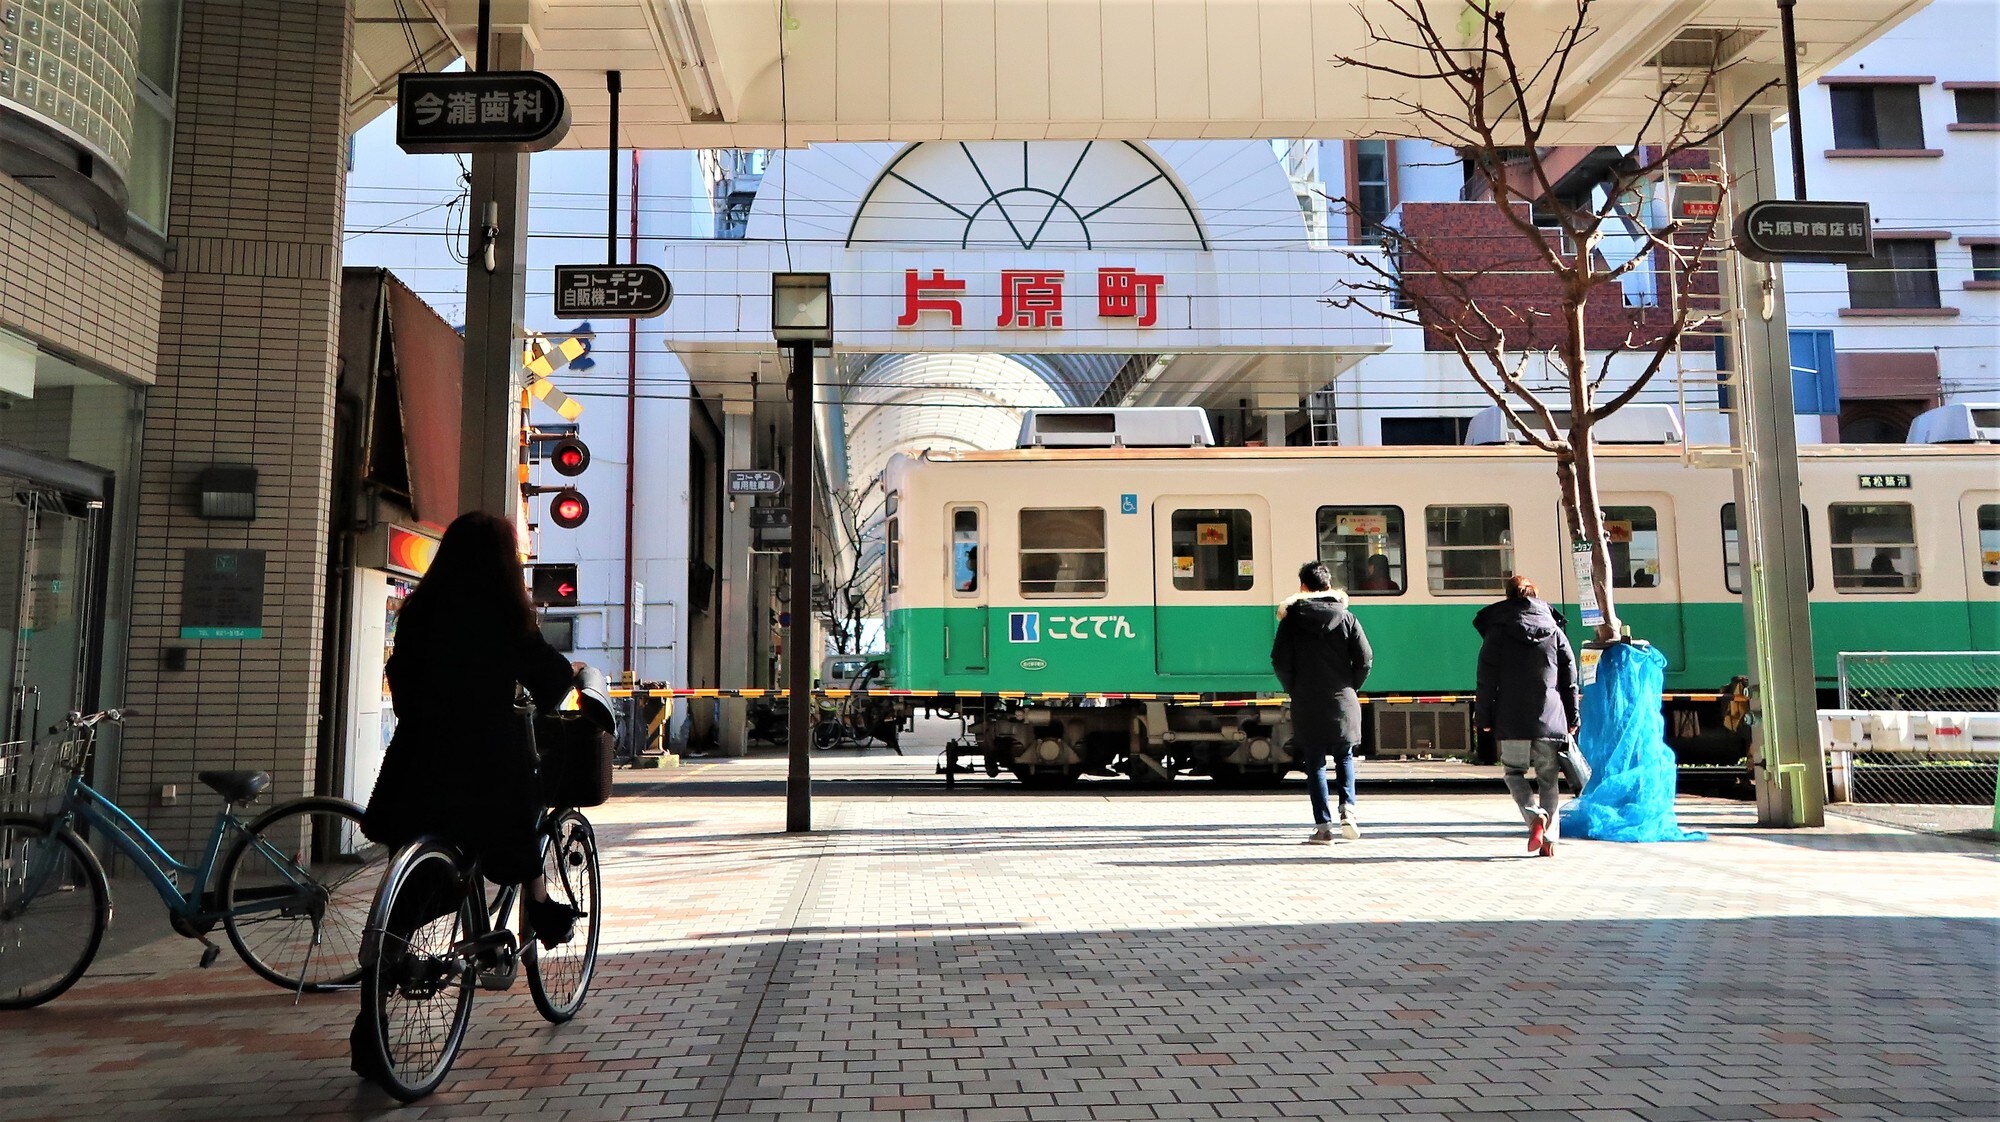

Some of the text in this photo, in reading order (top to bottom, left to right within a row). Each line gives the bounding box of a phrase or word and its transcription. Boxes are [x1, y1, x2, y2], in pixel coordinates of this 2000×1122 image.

[413, 90, 544, 126] 今瀧歯科
[1757, 220, 1863, 237] 片原町商店街
[573, 271, 644, 287] コトデン
[564, 287, 652, 307] 自販機コーナー
[897, 267, 1165, 328] 片原町
[1048, 615, 1136, 639] ことでん
